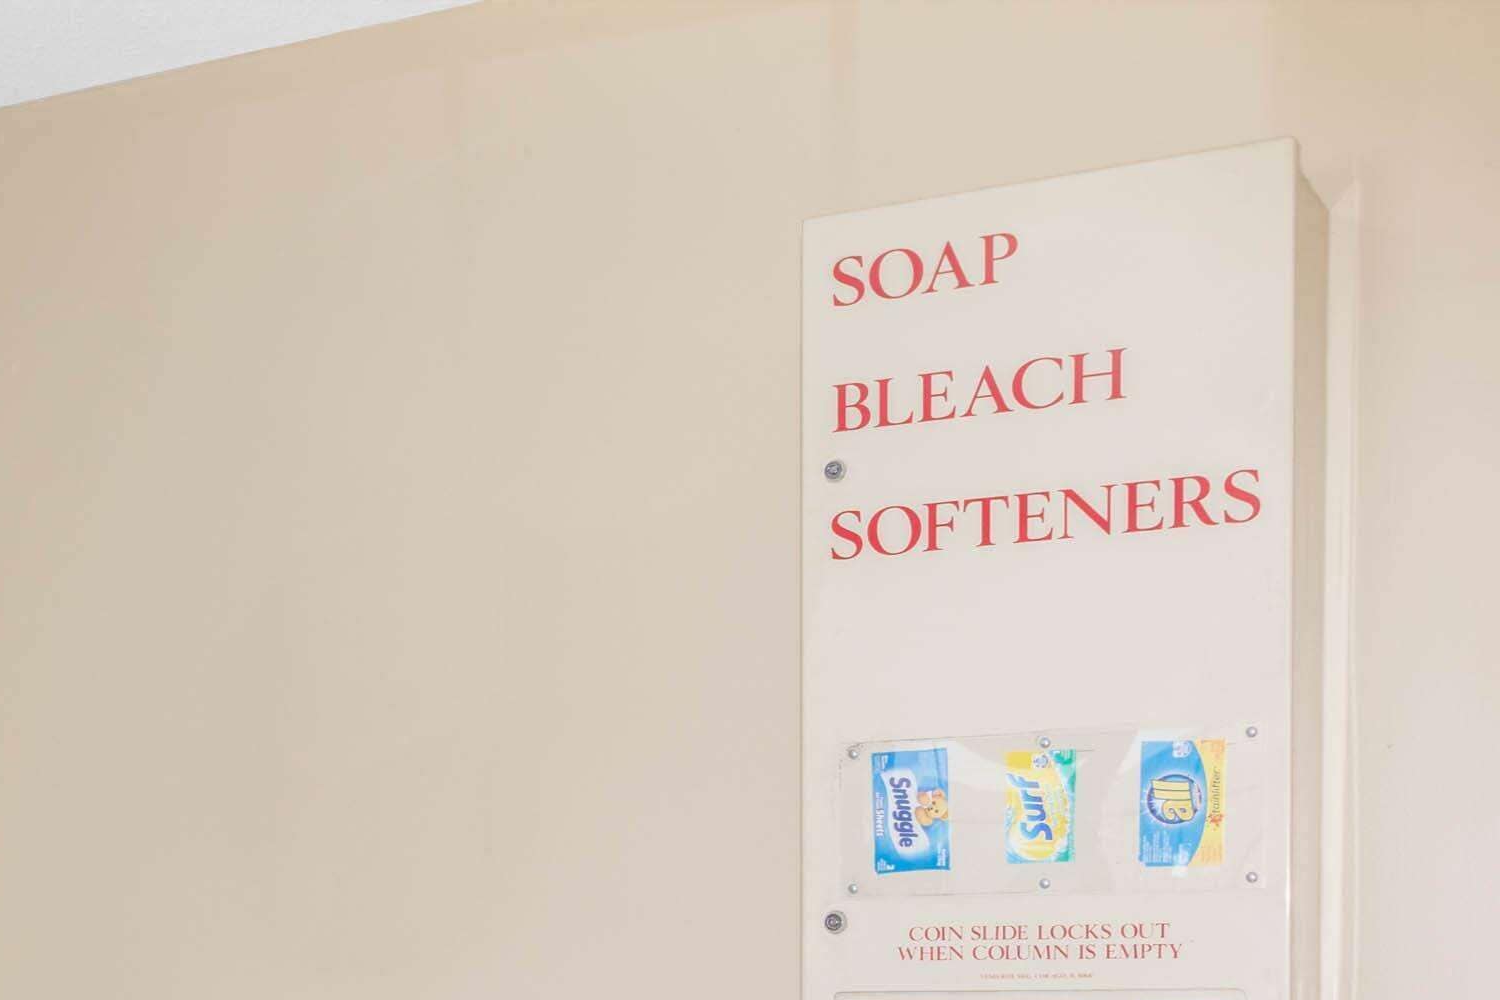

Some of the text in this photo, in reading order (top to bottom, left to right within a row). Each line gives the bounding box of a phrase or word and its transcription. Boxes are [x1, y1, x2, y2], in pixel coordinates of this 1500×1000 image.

[831, 232, 1019, 307] SOAP
[831, 346, 1129, 434] BLEACH
[829, 468, 1262, 561] SOFTENERS
[889, 776, 919, 848] Snuggle
[1005, 772, 1053, 841] Surf
[1151, 779, 1194, 821] all
[897, 942, 1183, 961] WHEN COLUMN IS EMPTY
[908, 922, 1171, 942] COIN SLIDE LOCKS OUT
